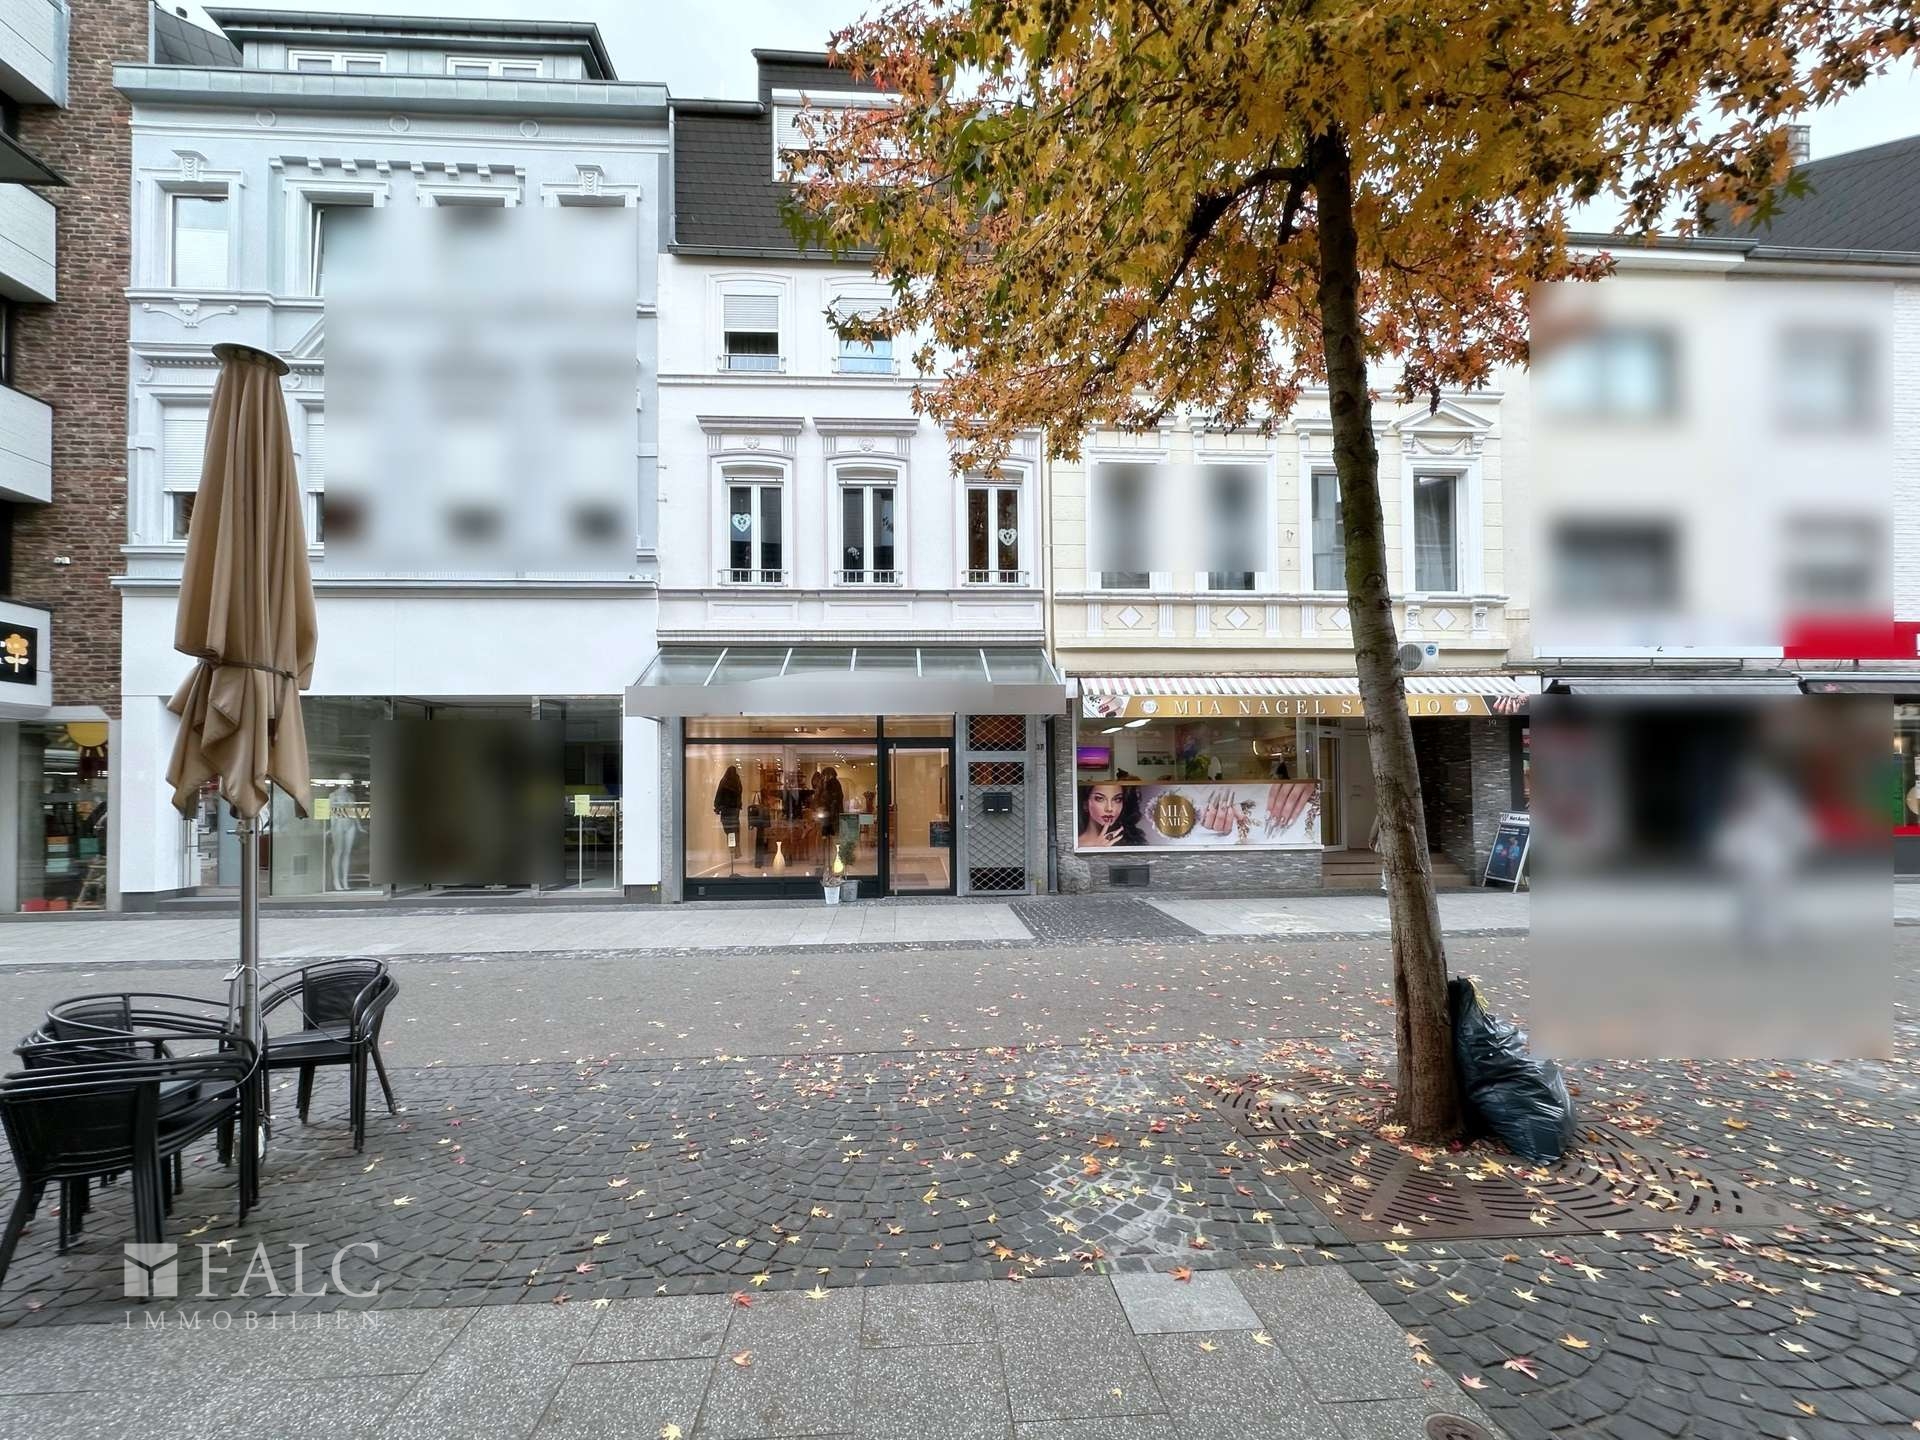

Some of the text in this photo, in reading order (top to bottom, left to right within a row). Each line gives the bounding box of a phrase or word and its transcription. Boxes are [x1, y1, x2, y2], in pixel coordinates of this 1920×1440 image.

[1174, 700, 1222, 714] MIA
[1239, 699, 1326, 714] NAGEL
[1341, 699, 1441, 714] SIO
[1160, 804, 1188, 817] MIA
[1160, 817, 1189, 826] NAILS
